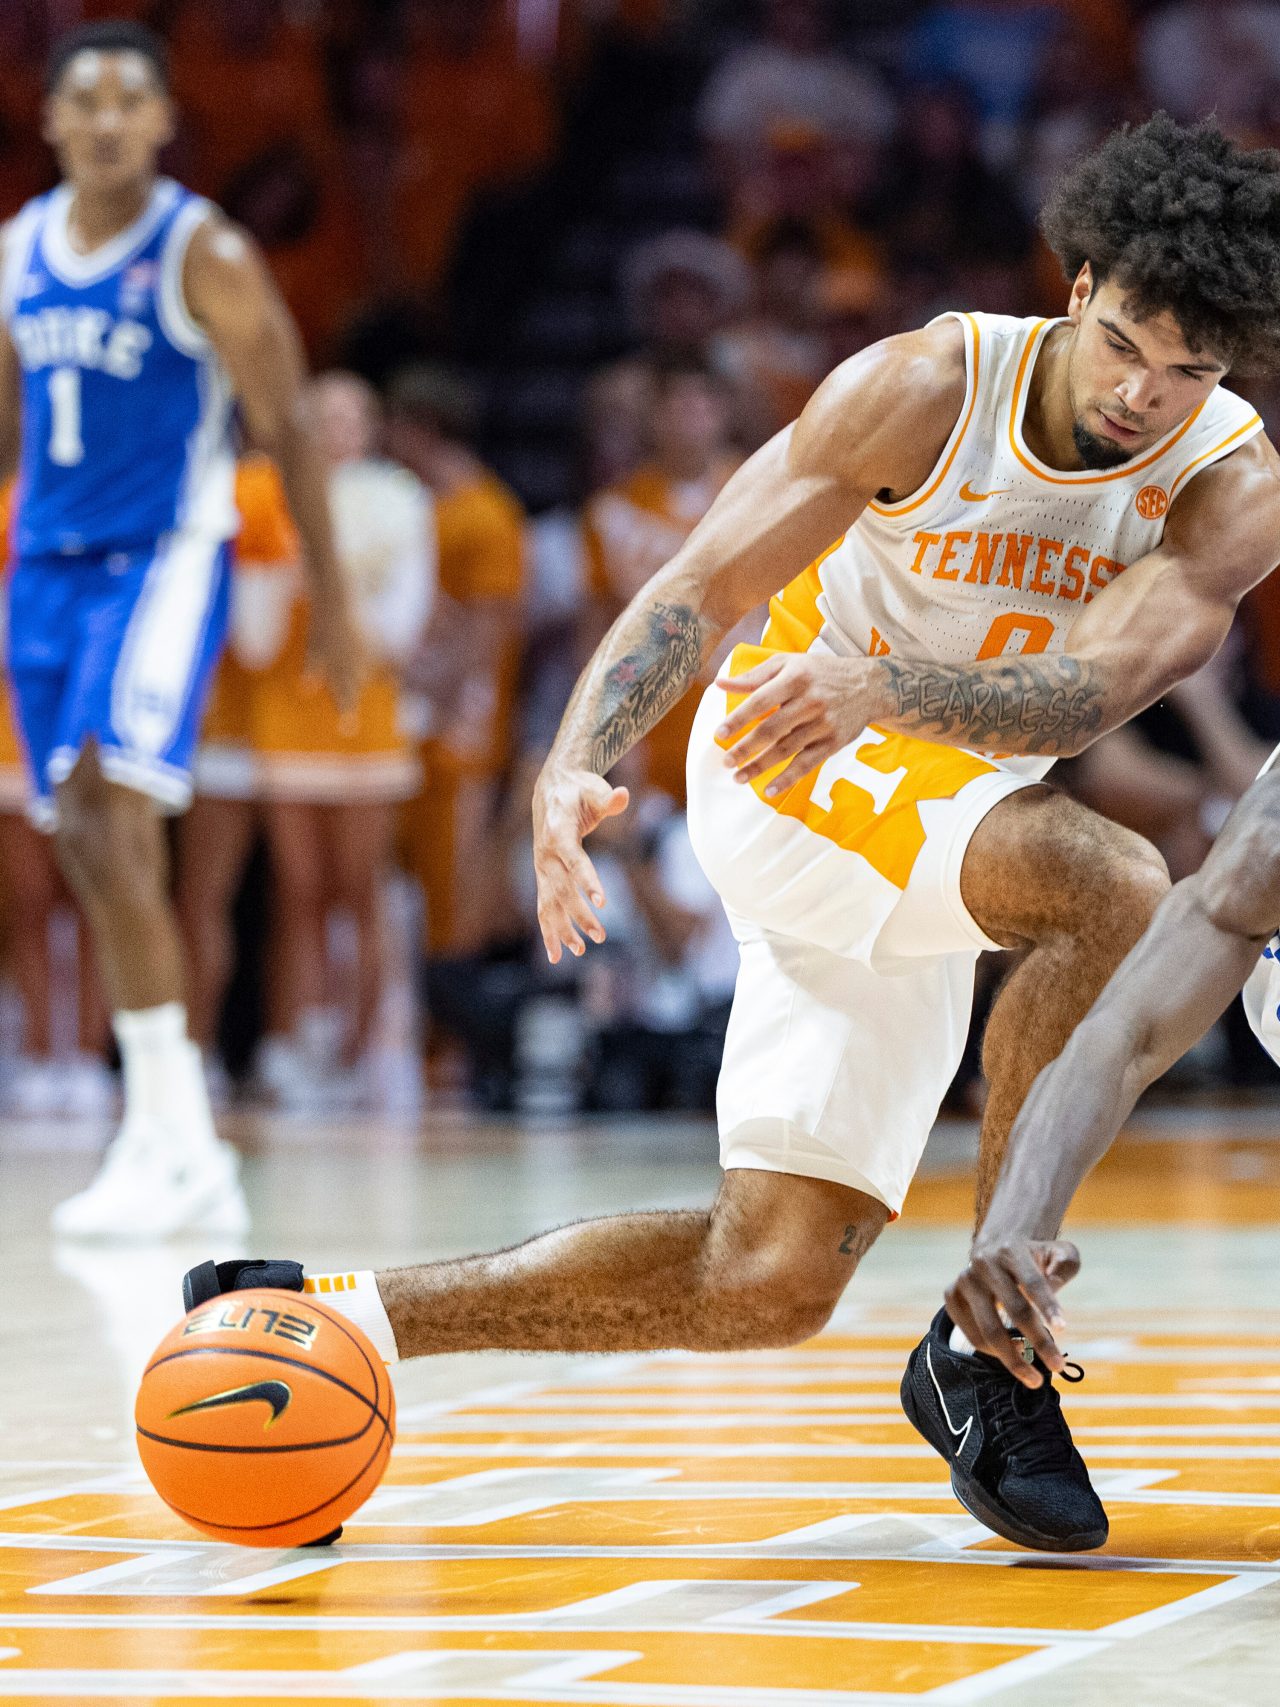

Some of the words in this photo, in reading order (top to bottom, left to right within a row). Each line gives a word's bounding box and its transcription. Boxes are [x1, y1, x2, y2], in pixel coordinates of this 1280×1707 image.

[13, 306, 154, 381] DUKE
[49, 367, 84, 467] 1
[1137, 487, 1167, 518] SEC
[893, 671, 1096, 735] FEARLESS
[809, 726, 908, 815] T
